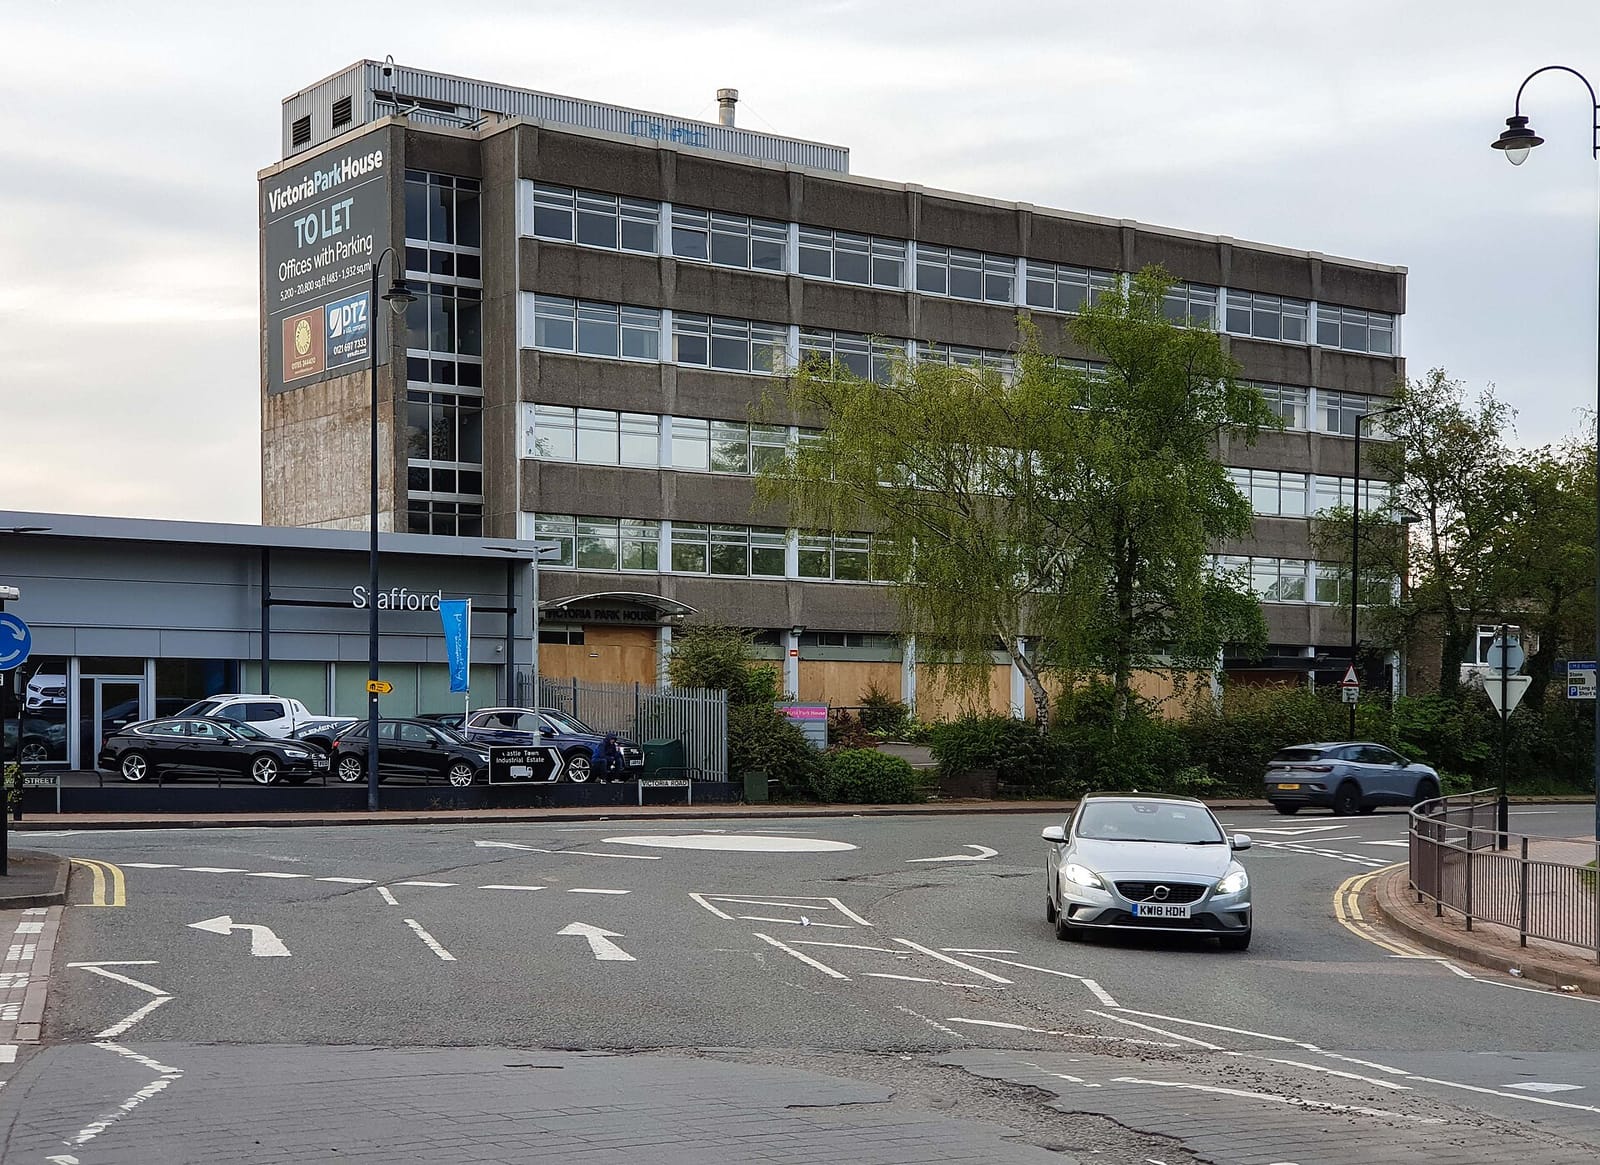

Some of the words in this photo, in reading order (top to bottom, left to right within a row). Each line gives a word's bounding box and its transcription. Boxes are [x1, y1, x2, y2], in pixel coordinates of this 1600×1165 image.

[269, 150, 383, 213] VictoriaParkHouse
[294, 213, 319, 249] TO
[321, 197, 354, 239] LET
[278, 257, 312, 282] Offices
[313, 244, 335, 269] with
[336, 234, 373, 259] Parking
[280, 287, 294, 301] 5,200
[297, 280, 315, 295] 20,800
[341, 264, 356, 280] 1,932
[342, 299, 367, 327] DTZ
[352, 586, 442, 611] Safford
[594, 610, 620, 620] PARK
[298, 722, 339, 738] ELEMENT
[1140, 905, 1163, 916] KW18
[1165, 906, 1186, 917] HDH
